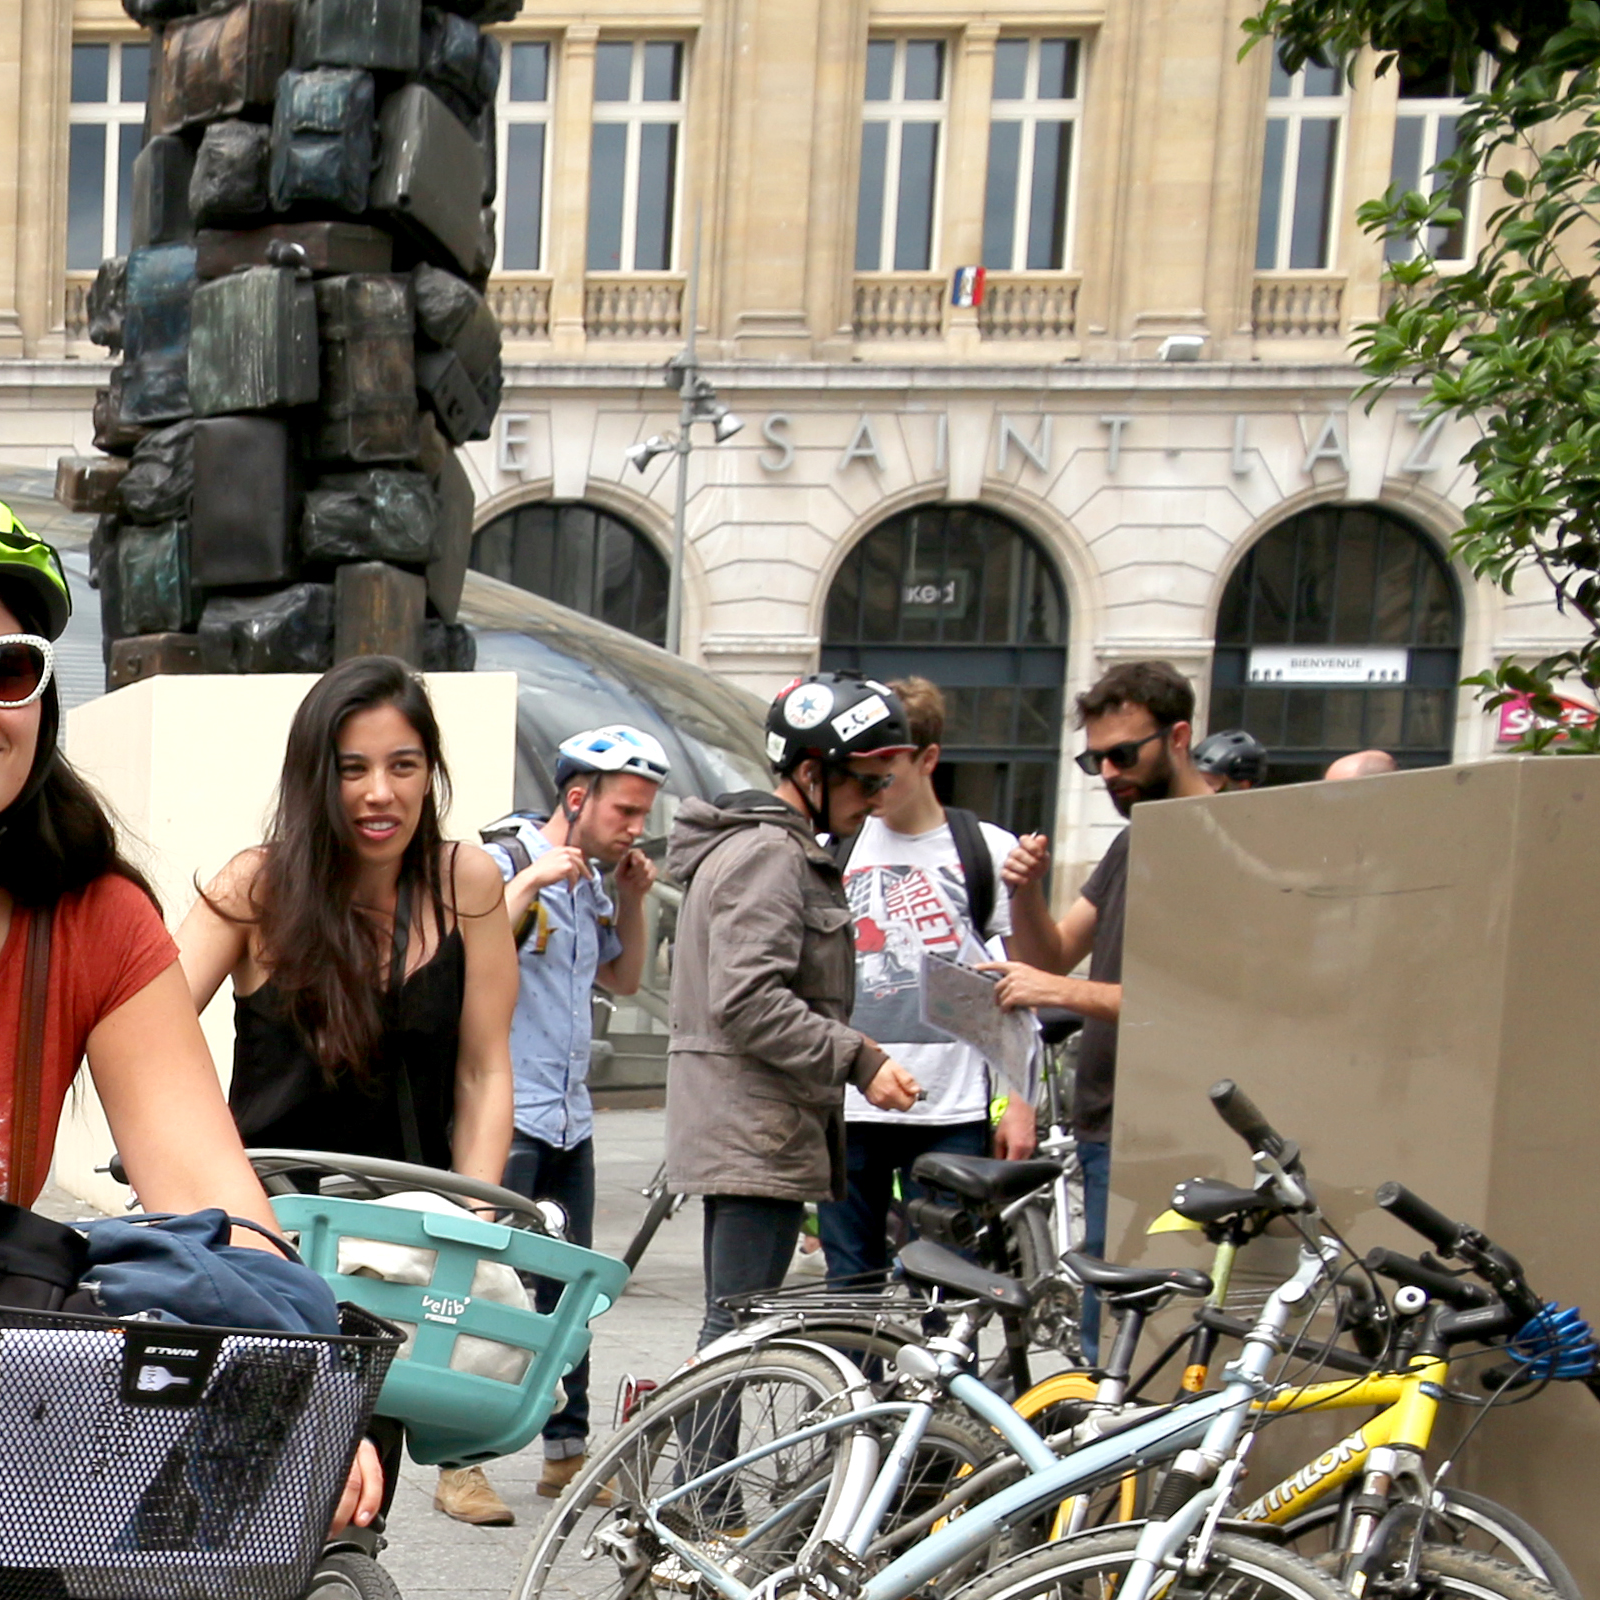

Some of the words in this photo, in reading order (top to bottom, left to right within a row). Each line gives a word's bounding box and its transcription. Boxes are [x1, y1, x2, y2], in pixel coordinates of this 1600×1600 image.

[759, 411, 1132, 474] SAINT
[1290, 657, 1363, 668] BIENVENUE
[903, 869, 962, 949] STREET
